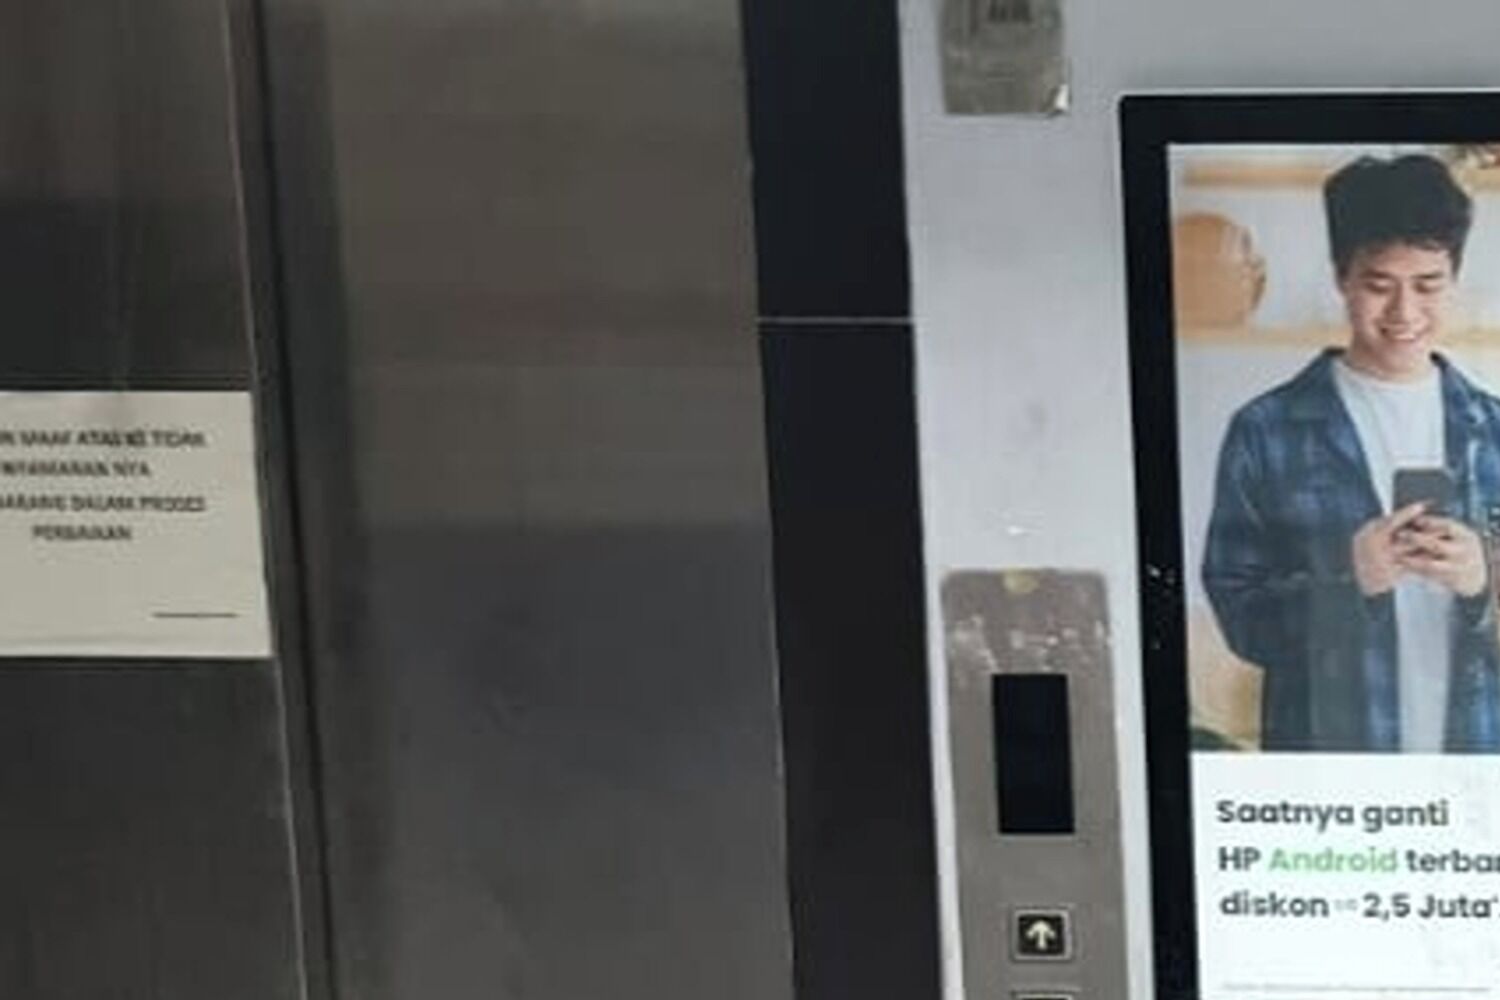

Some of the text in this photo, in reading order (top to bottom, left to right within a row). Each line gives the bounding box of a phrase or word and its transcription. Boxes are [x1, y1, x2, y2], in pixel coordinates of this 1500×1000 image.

[1216, 798, 1449, 833] Saatnya ganti
[1218, 847, 1261, 872] HP
[1268, 846, 1398, 873] Android
[1220, 890, 1329, 917] diskon
[1363, 892, 1410, 921] 2,5
